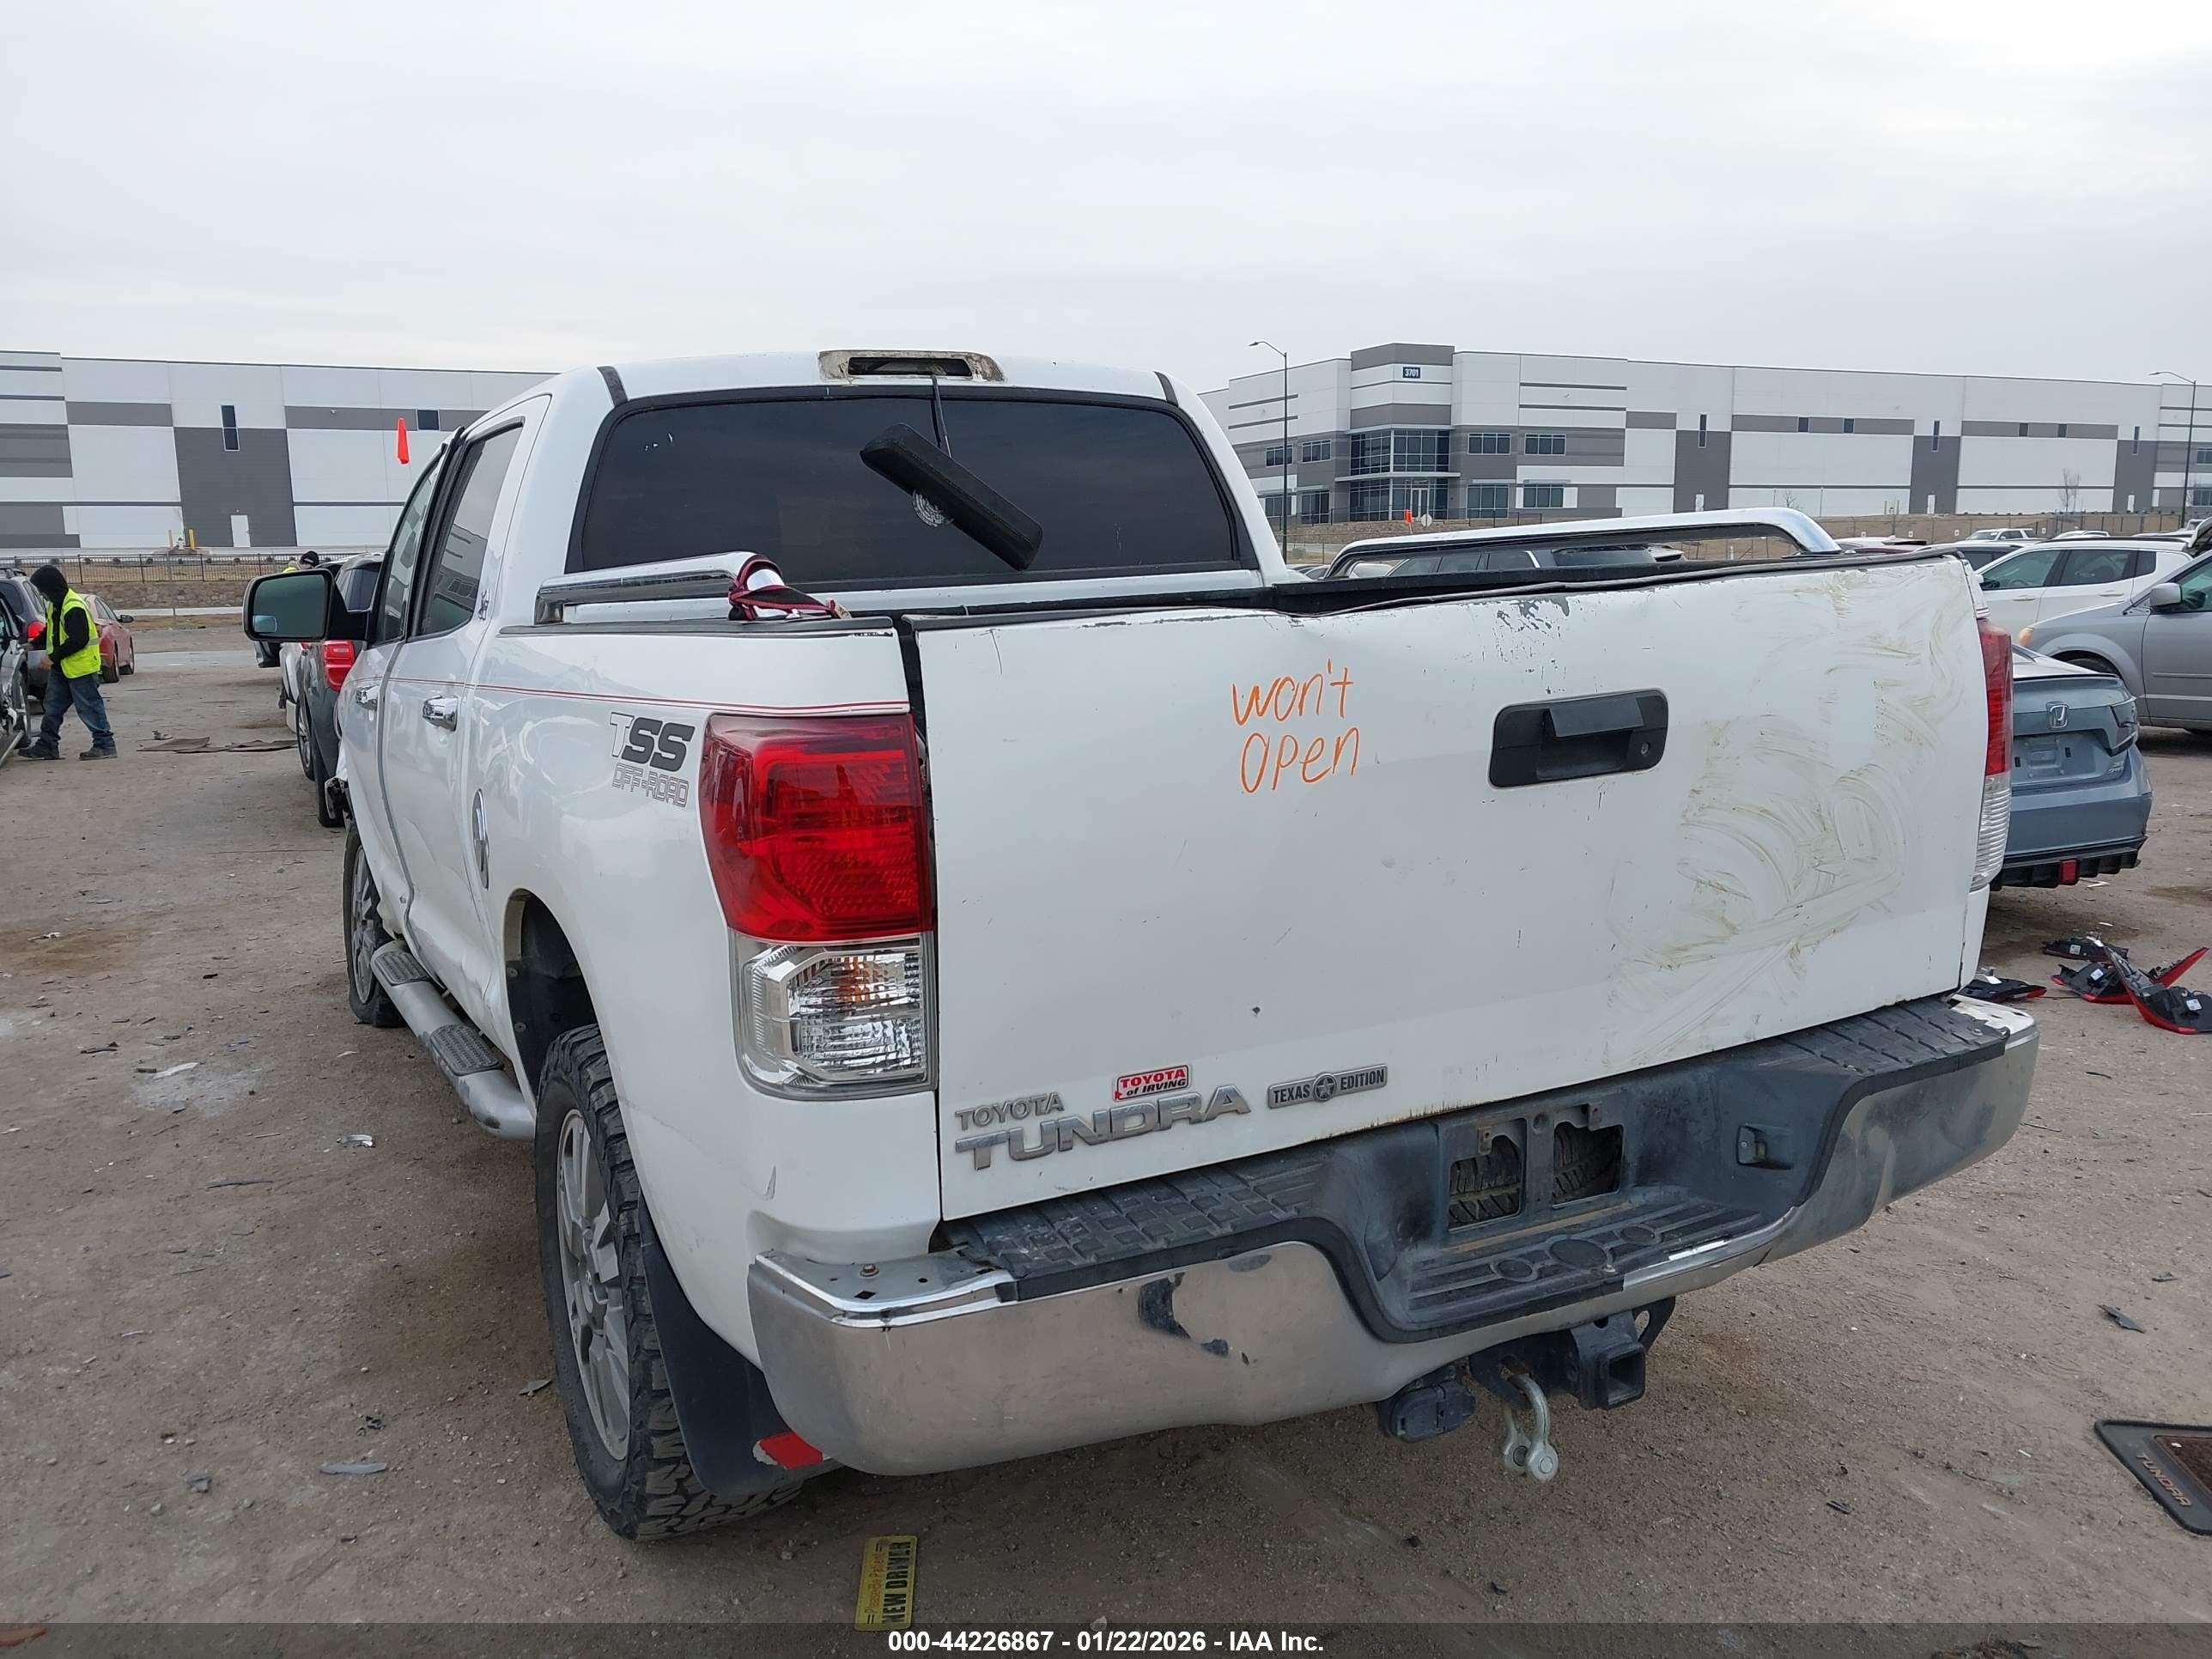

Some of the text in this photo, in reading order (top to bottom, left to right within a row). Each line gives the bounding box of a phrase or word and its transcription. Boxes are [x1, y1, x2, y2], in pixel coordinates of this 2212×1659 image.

[1404, 368, 1419, 377] 3701
[1232, 659, 1354, 726] won't
[610, 712, 696, 772] TSS
[611, 762, 689, 808] OFF-ROAD
[1120, 1068, 1186, 1089] TOYOTA
[1127, 1078, 1187, 1097] of IRVING
[1273, 1068, 1385, 1103] TEXAS EDITION
[955, 1091, 1065, 1131] TOYOTA
[955, 1084, 1251, 1171] TUNDRA
[2136, 1452, 2192, 1507] TUNDRA
[882, 1541, 911, 1623] NEW DRIVER
